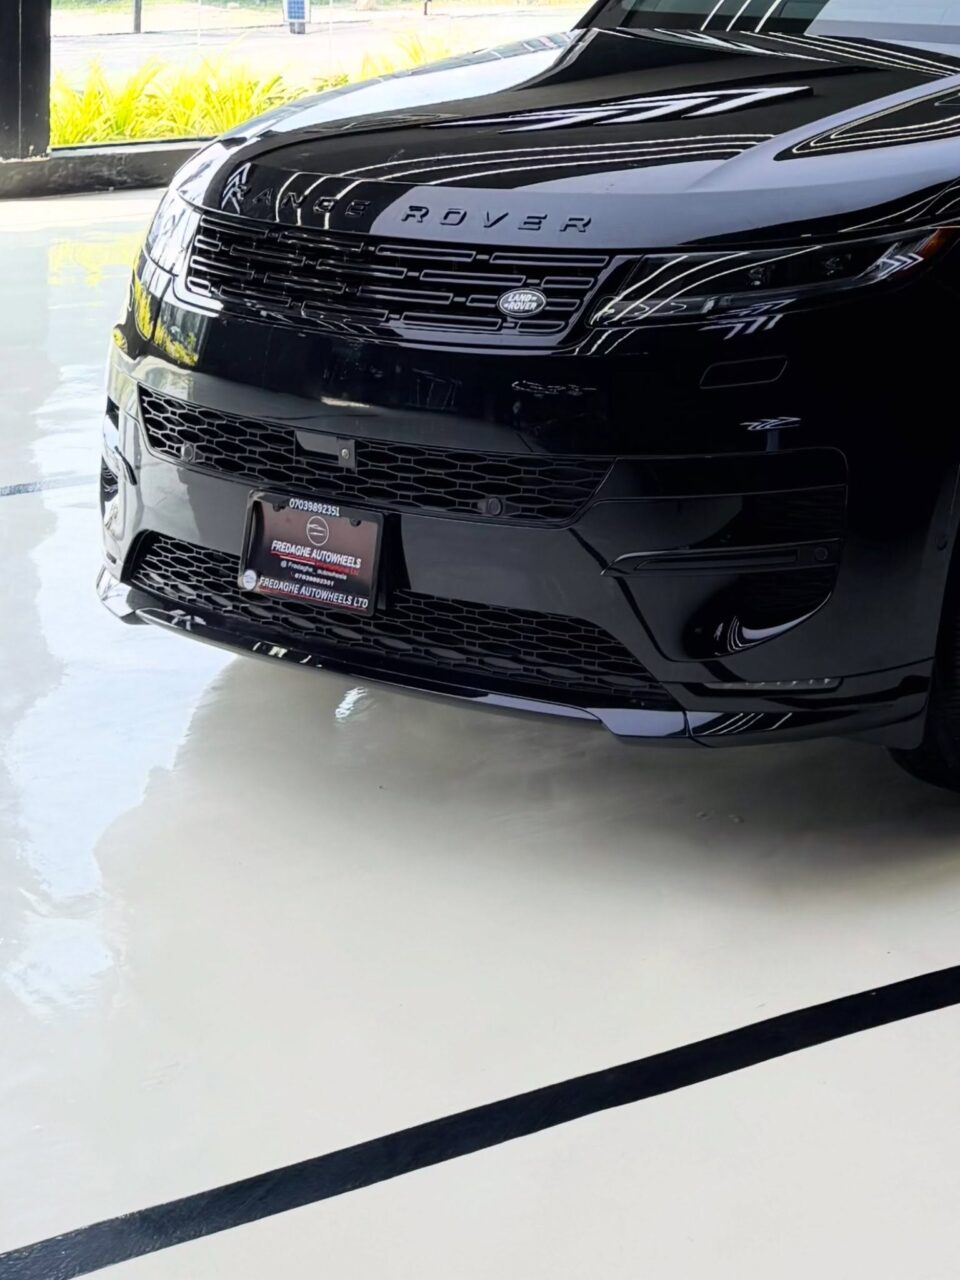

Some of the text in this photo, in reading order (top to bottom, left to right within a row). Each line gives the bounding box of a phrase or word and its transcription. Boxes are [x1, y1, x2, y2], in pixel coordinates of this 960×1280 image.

[400, 205, 593, 233] ROVER
[271, 540, 312, 558] FREDAGHE
[311, 549, 362, 569] AUTOWHEELS
[258, 577, 369, 609] FREDAGHE AUTOWHEELS LTD
